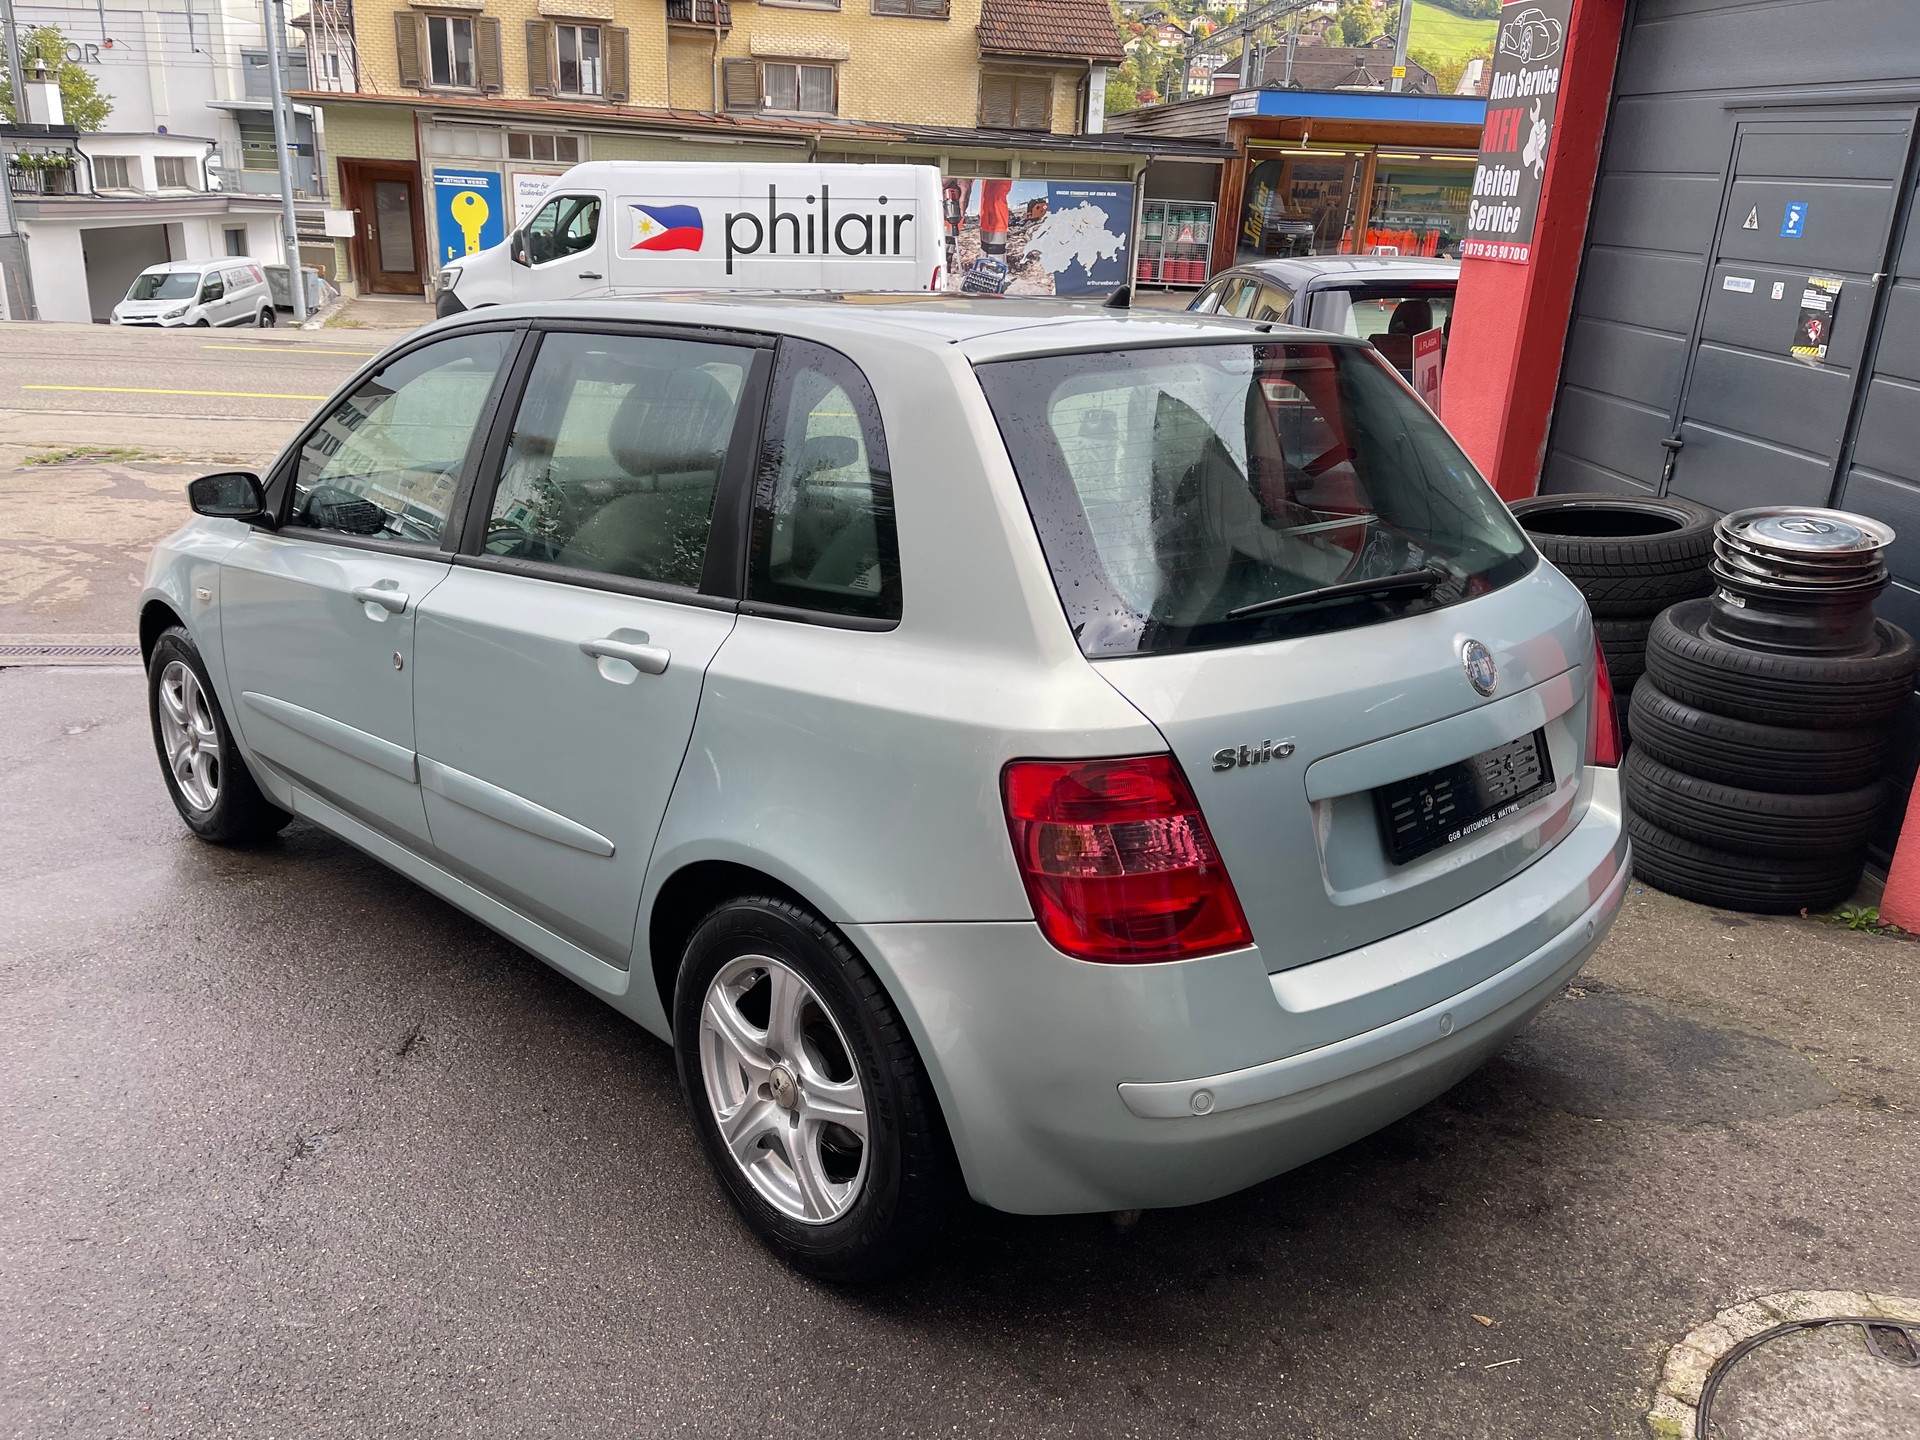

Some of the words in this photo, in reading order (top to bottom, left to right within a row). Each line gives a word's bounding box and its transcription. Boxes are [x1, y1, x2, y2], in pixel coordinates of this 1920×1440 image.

[1490, 71, 1517, 100] Auto
[1516, 64, 1559, 97] Service
[1481, 107, 1524, 153] MFK
[1472, 165, 1521, 197] Reifen
[725, 184, 914, 274] philair
[1244, 181, 1270, 249] Snickers
[1468, 199, 1521, 234] Service
[1422, 338, 1437, 350] FLAGA
[1469, 656, 1494, 680] FIAT
[1212, 739, 1296, 772] Stilo
[1448, 830, 1461, 842] GGB
[1463, 813, 1497, 836] AUTOMOBILE
